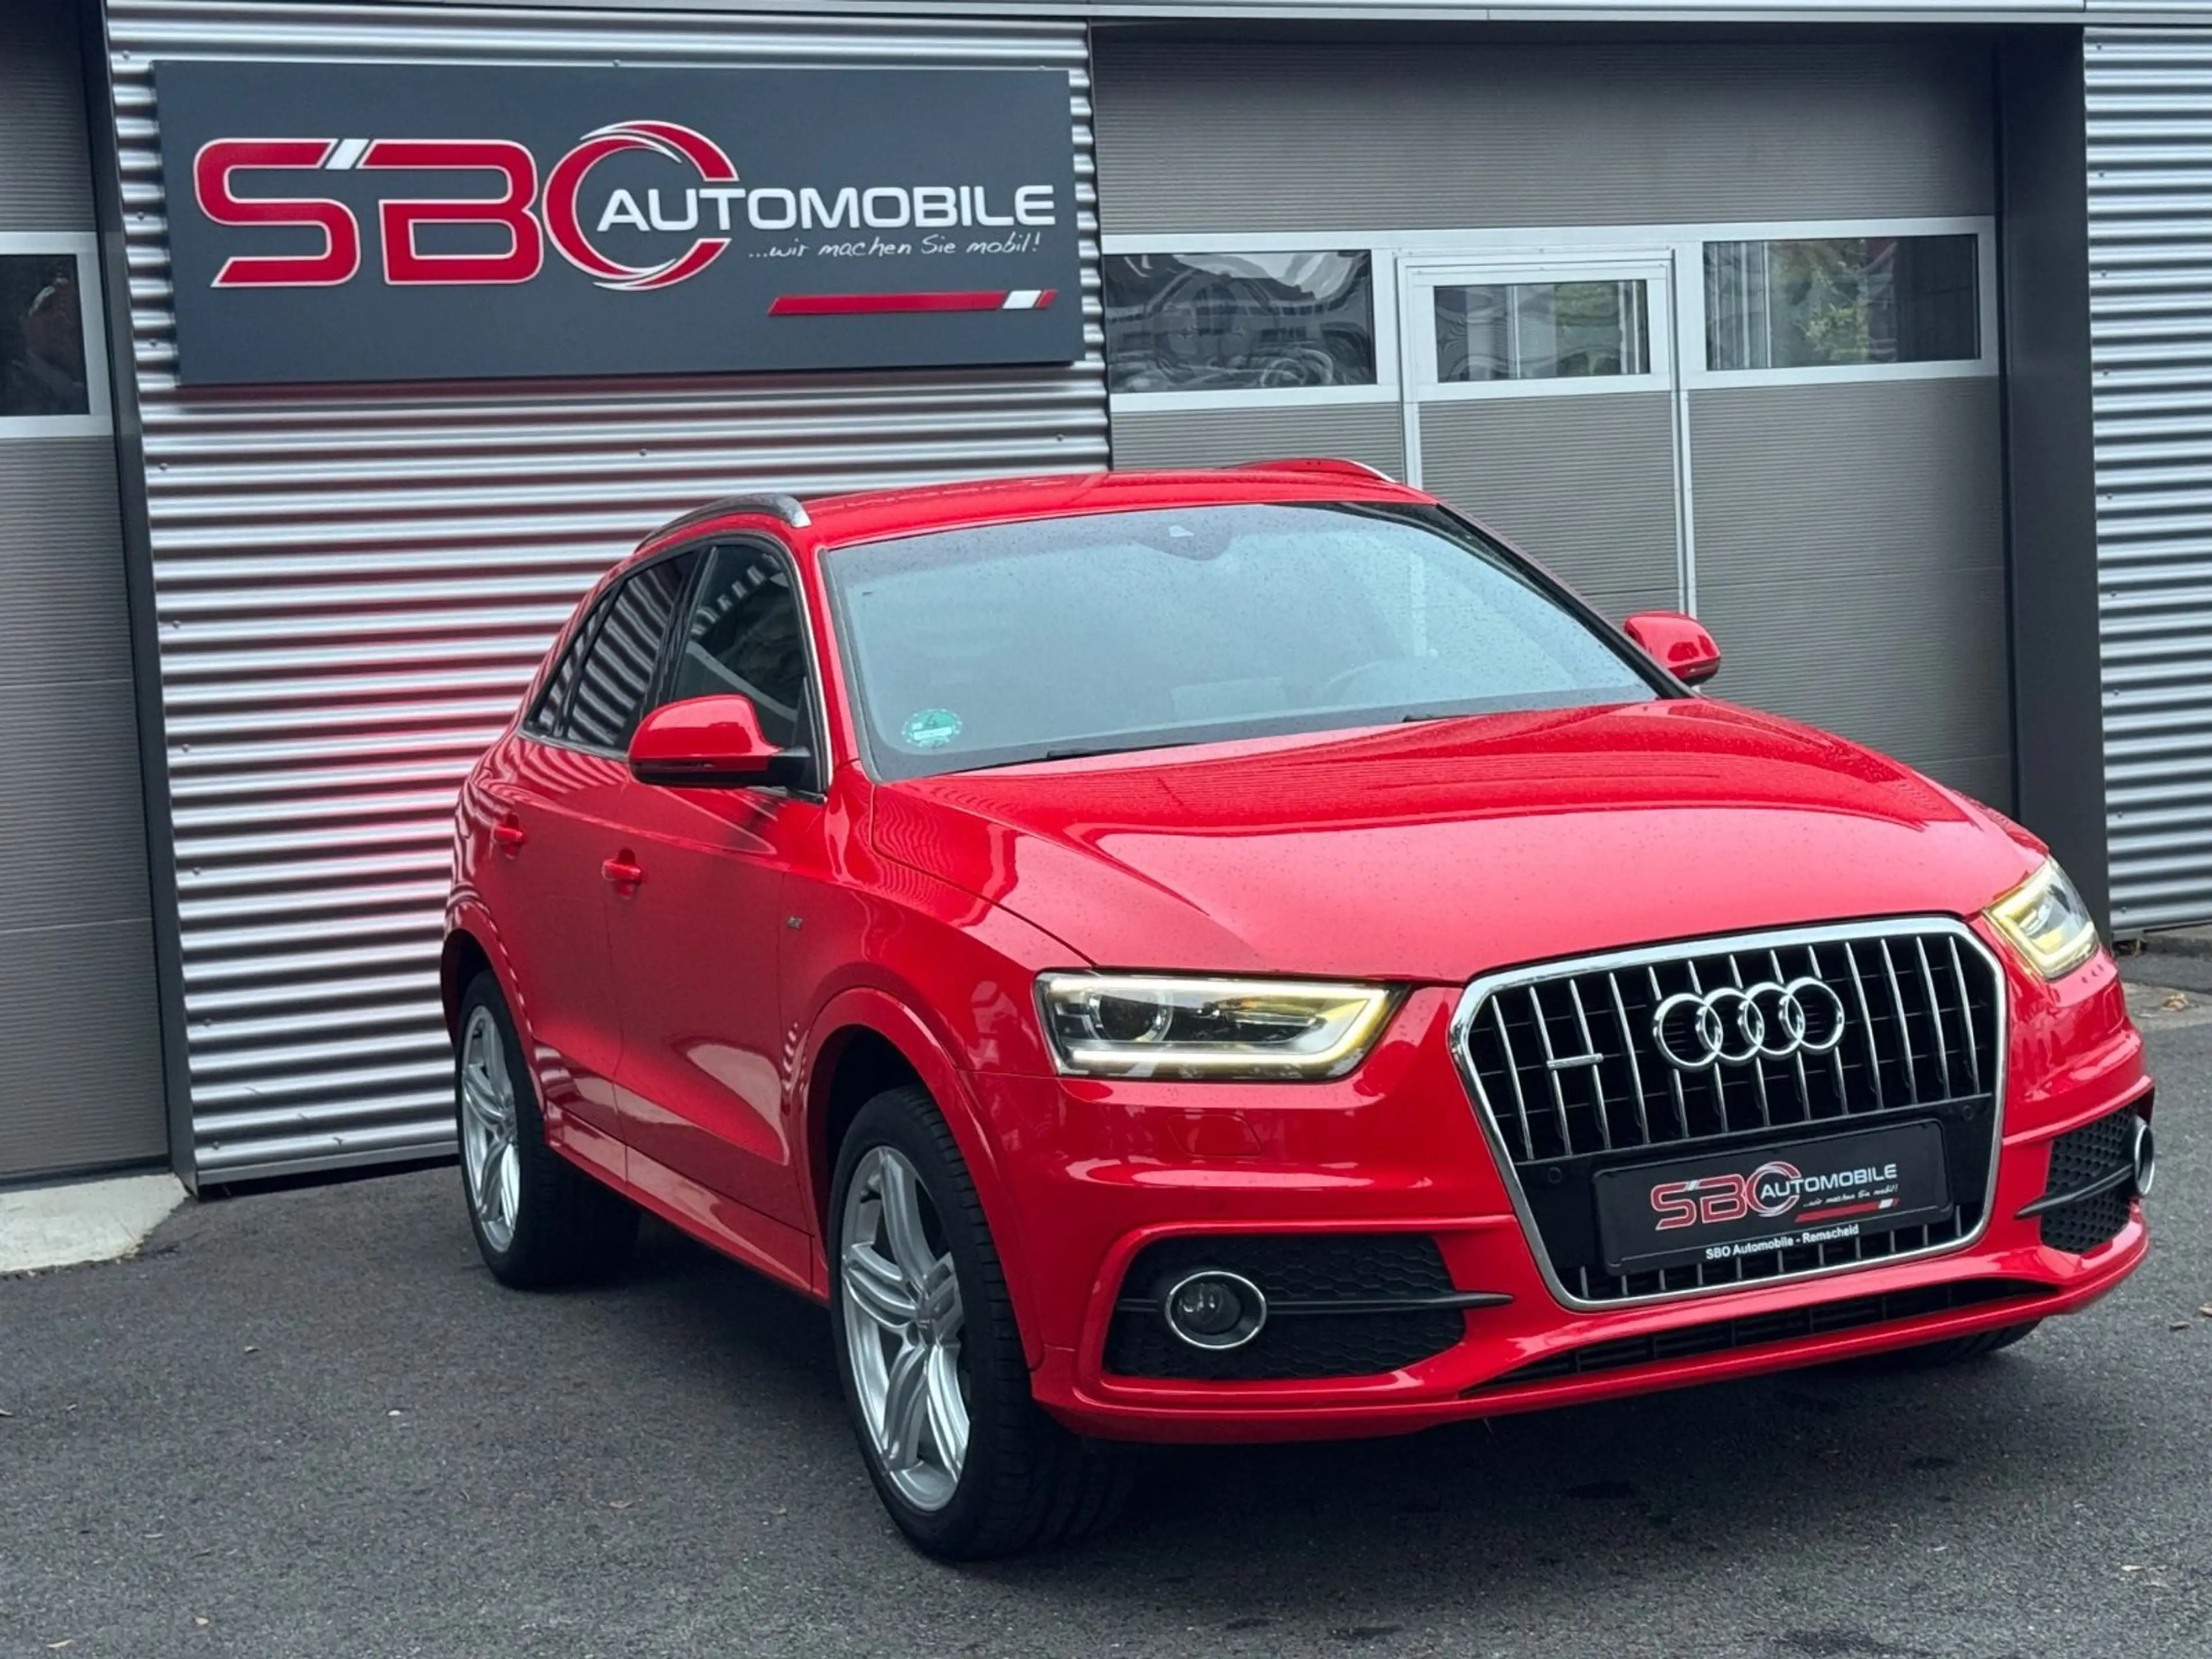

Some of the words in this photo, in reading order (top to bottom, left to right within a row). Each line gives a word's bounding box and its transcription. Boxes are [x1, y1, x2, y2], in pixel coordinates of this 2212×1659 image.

[597, 184, 1055, 233] AUTOMOBILE
[748, 237, 809, 257] ...wir
[818, 236, 912, 257] machen
[921, 234, 957, 254] Sie
[966, 231, 1040, 254] mobil!
[1760, 1163, 1897, 1200] AUTOMOBILE
[1705, 1247, 1731, 1260] SBO
[1732, 1237, 1794, 1256] Automobile
[1801, 1224, 1859, 1244] Remscheid
